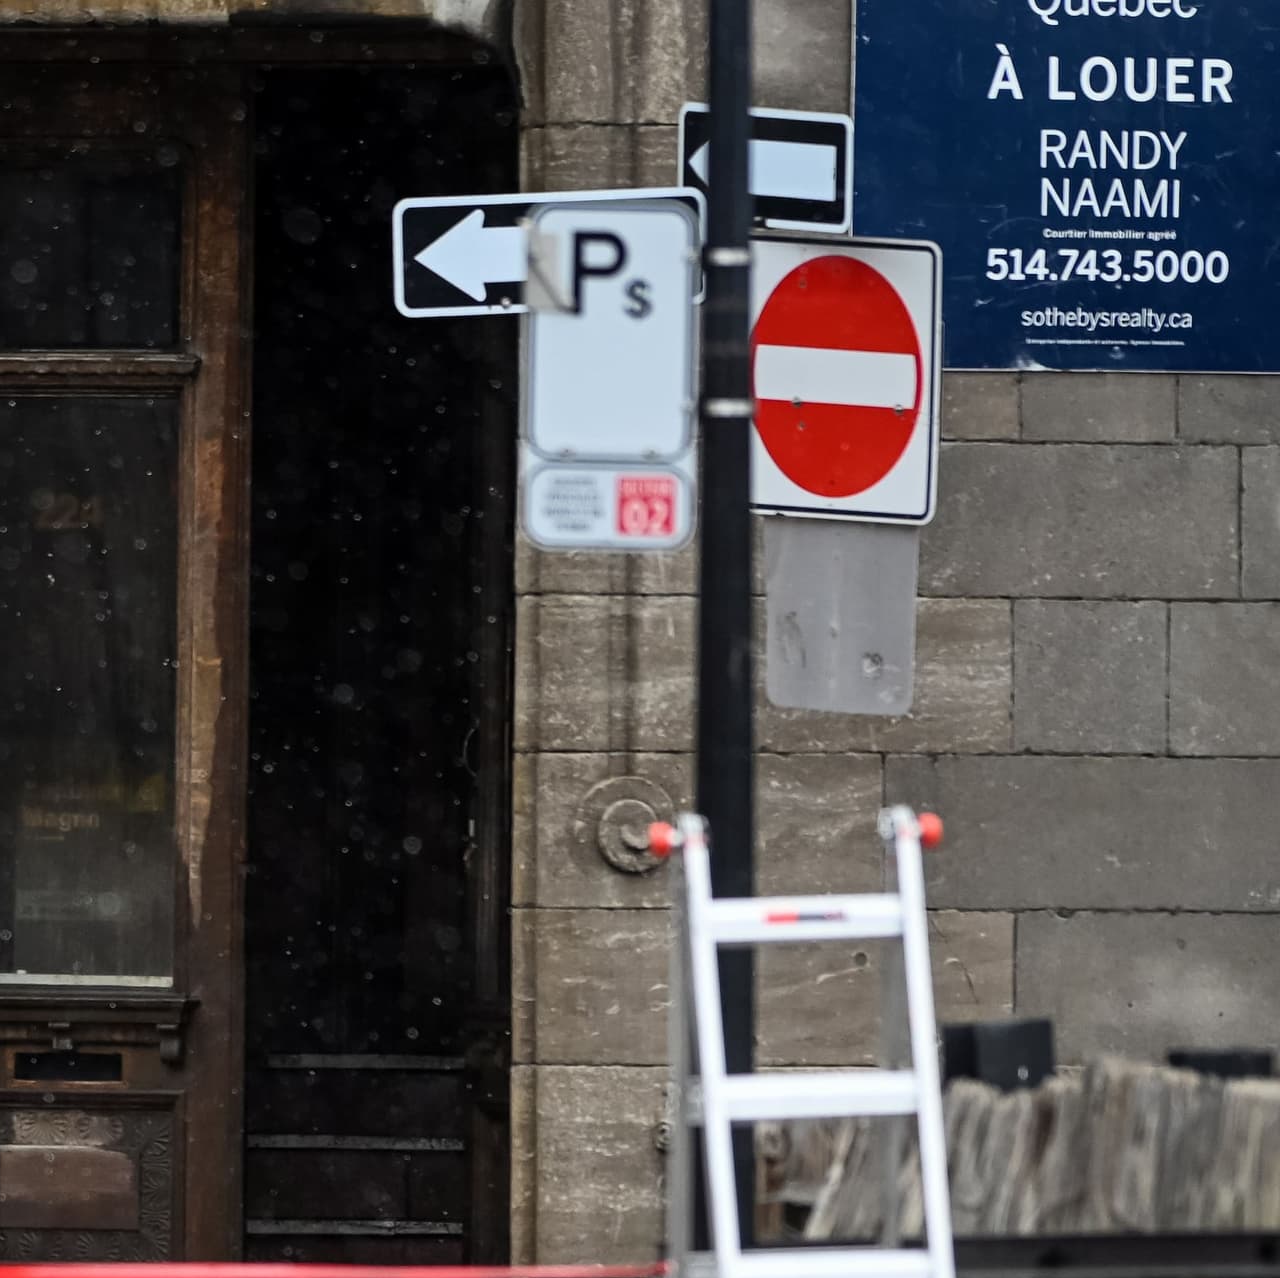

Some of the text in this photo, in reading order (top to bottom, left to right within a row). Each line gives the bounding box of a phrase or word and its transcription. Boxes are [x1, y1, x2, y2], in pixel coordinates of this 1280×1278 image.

[987, 43, 1234, 103] À LOUER
[1040, 129, 1187, 170] RANDY
[1040, 178, 1181, 219] NAAMI
[1042, 228, 1088, 239] Courtier
[985, 247, 1230, 284] 514.743.5000
[1020, 307, 1193, 333] sothebysrealty.ca
[622, 500, 669, 536] 02
